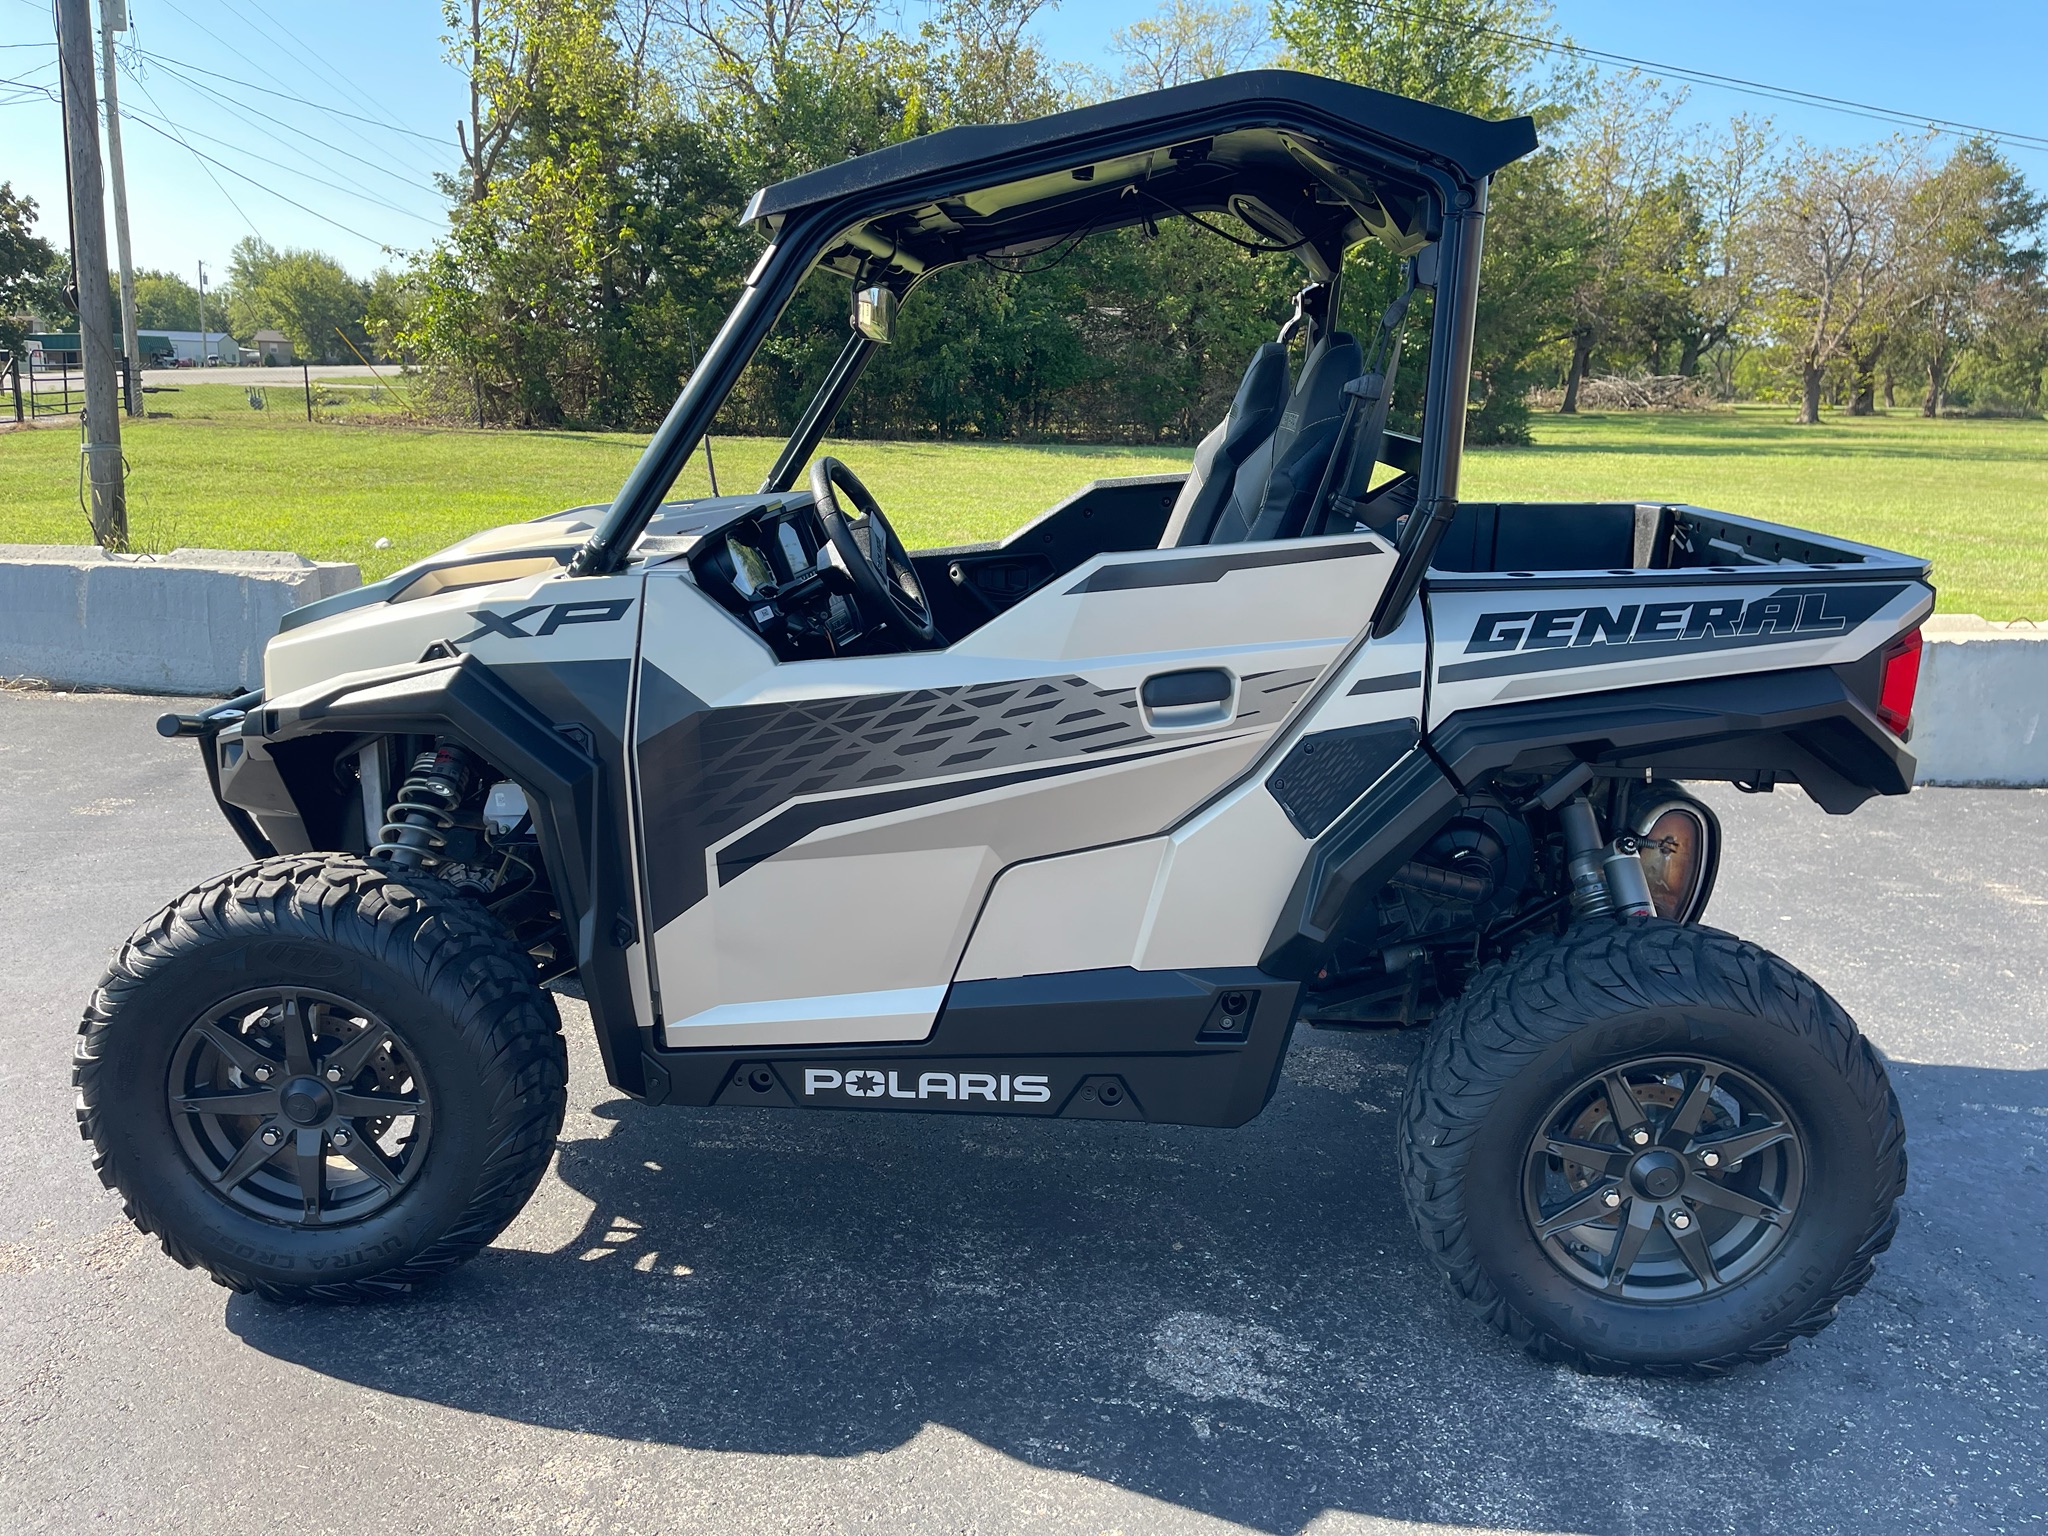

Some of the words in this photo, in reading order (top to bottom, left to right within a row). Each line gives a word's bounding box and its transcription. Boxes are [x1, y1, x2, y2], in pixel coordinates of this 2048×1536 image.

[452, 598, 635, 644] XP
[1463, 592, 1847, 655] GENERAL
[804, 1068, 1052, 1103] POLARIS
[307, 1235, 405, 1271] ULTRA
[1733, 1265, 1823, 1332] ULTRA
